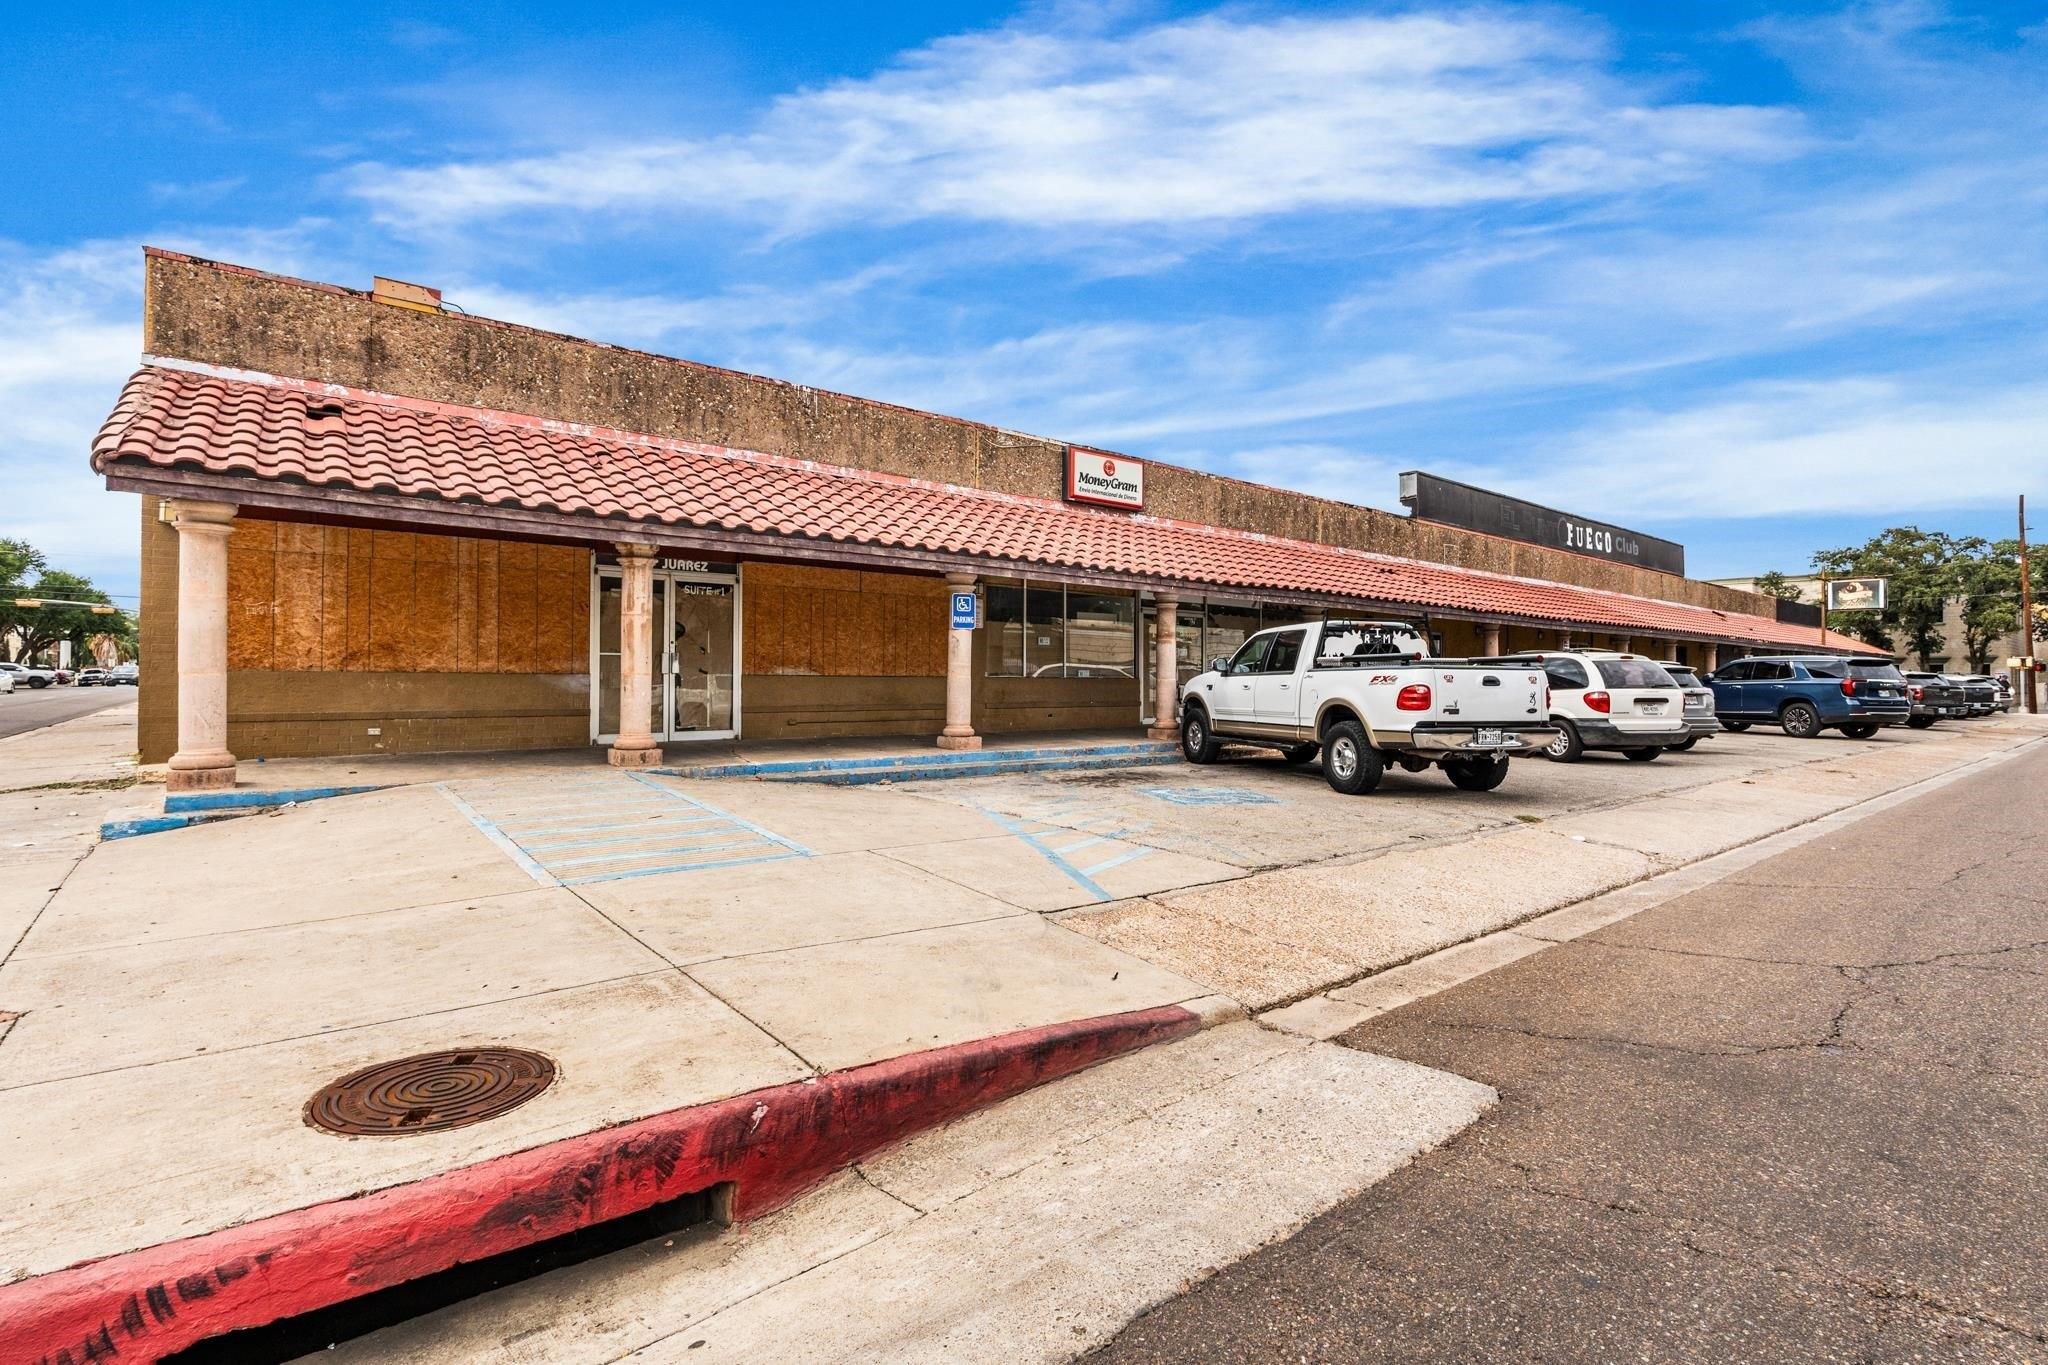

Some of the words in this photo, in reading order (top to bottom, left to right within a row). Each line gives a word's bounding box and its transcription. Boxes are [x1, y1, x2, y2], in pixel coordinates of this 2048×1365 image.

[1078, 471, 1138, 493] MoneyGram
[1566, 522, 1612, 553] FUEGO
[1615, 536, 1639, 556] Club
[661, 558, 708, 572] JUAREZ
[684, 584, 713, 596] SUITE
[953, 615, 974, 624] PARKING
